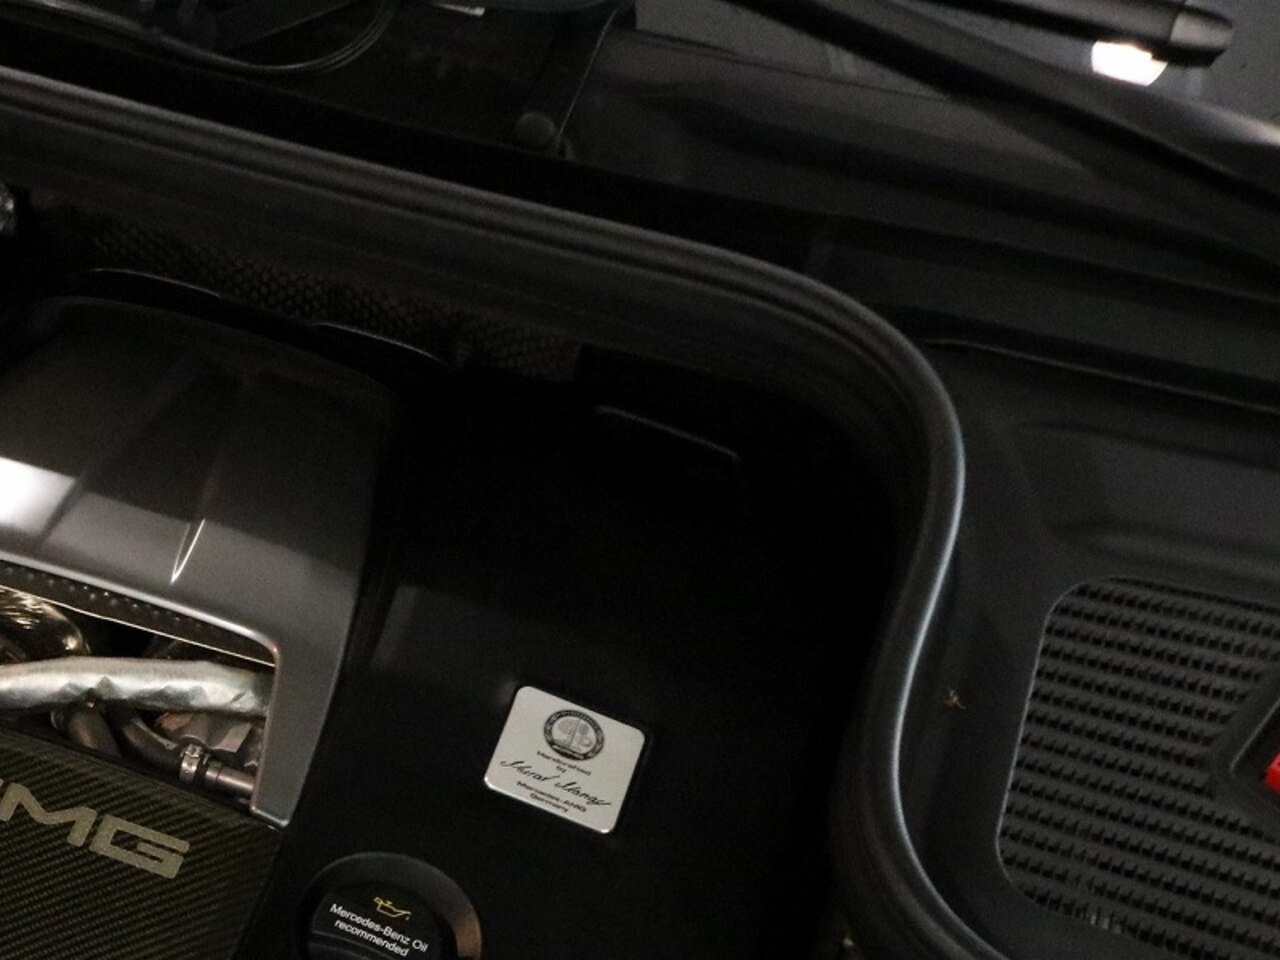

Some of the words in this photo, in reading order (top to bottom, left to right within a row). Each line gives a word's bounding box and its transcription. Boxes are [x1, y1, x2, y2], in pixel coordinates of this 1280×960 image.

[329, 903, 411, 945] Mercedes-Benz
[412, 939, 430, 953] Oil
[334, 919, 410, 957] recommended
